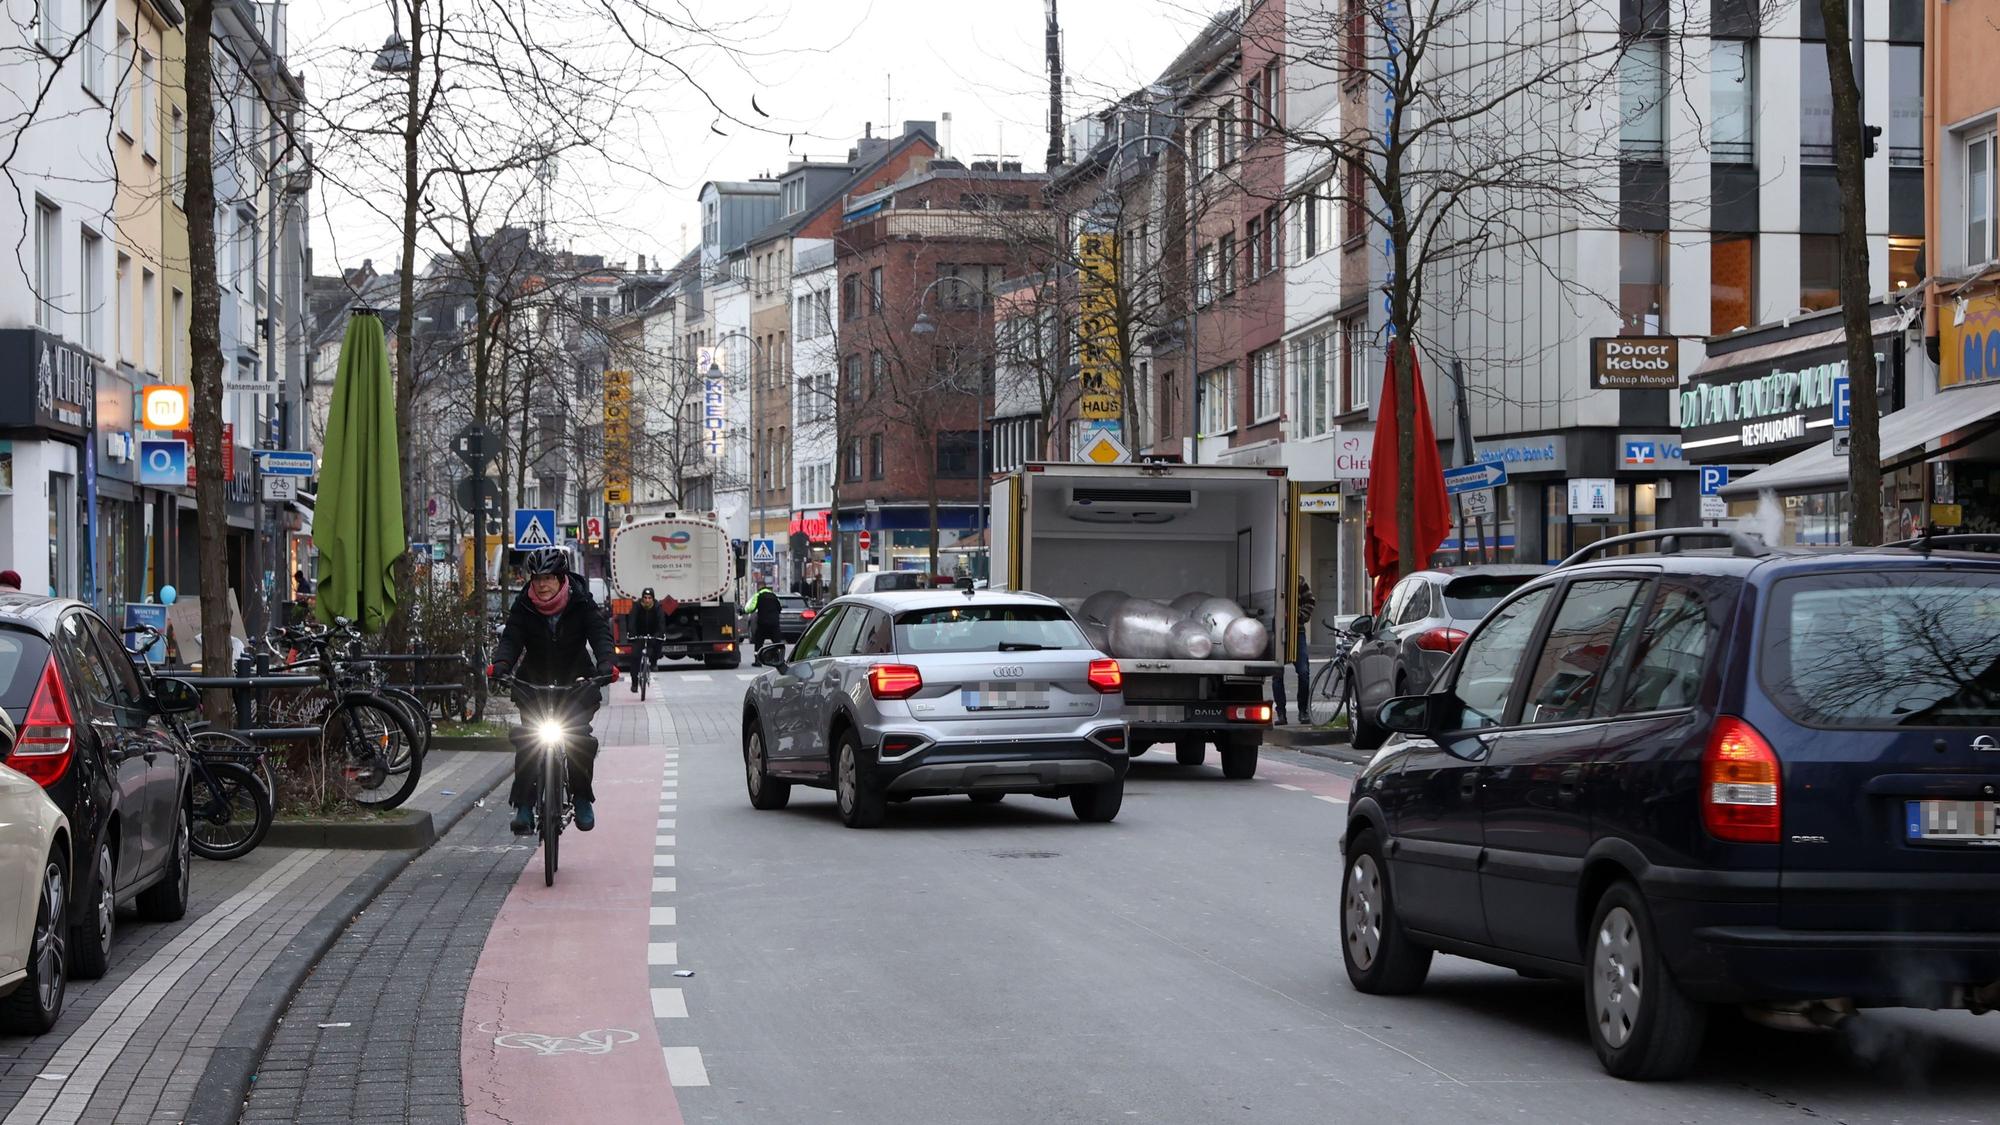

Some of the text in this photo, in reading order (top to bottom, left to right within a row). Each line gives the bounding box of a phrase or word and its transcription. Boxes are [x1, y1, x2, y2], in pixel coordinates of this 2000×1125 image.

[1606, 342, 1669, 355] Döner
[1606, 357, 1669, 370] Kebab
[1609, 375, 1675, 385] Antep Mangal
[1083, 401, 1118, 412] HAUS
[705, 380, 722, 454] KREDIT
[1742, 415, 1805, 446] RESTAURANT
[1446, 472, 1488, 485] Einbahnstraße
[1704, 469, 1720, 492] P
